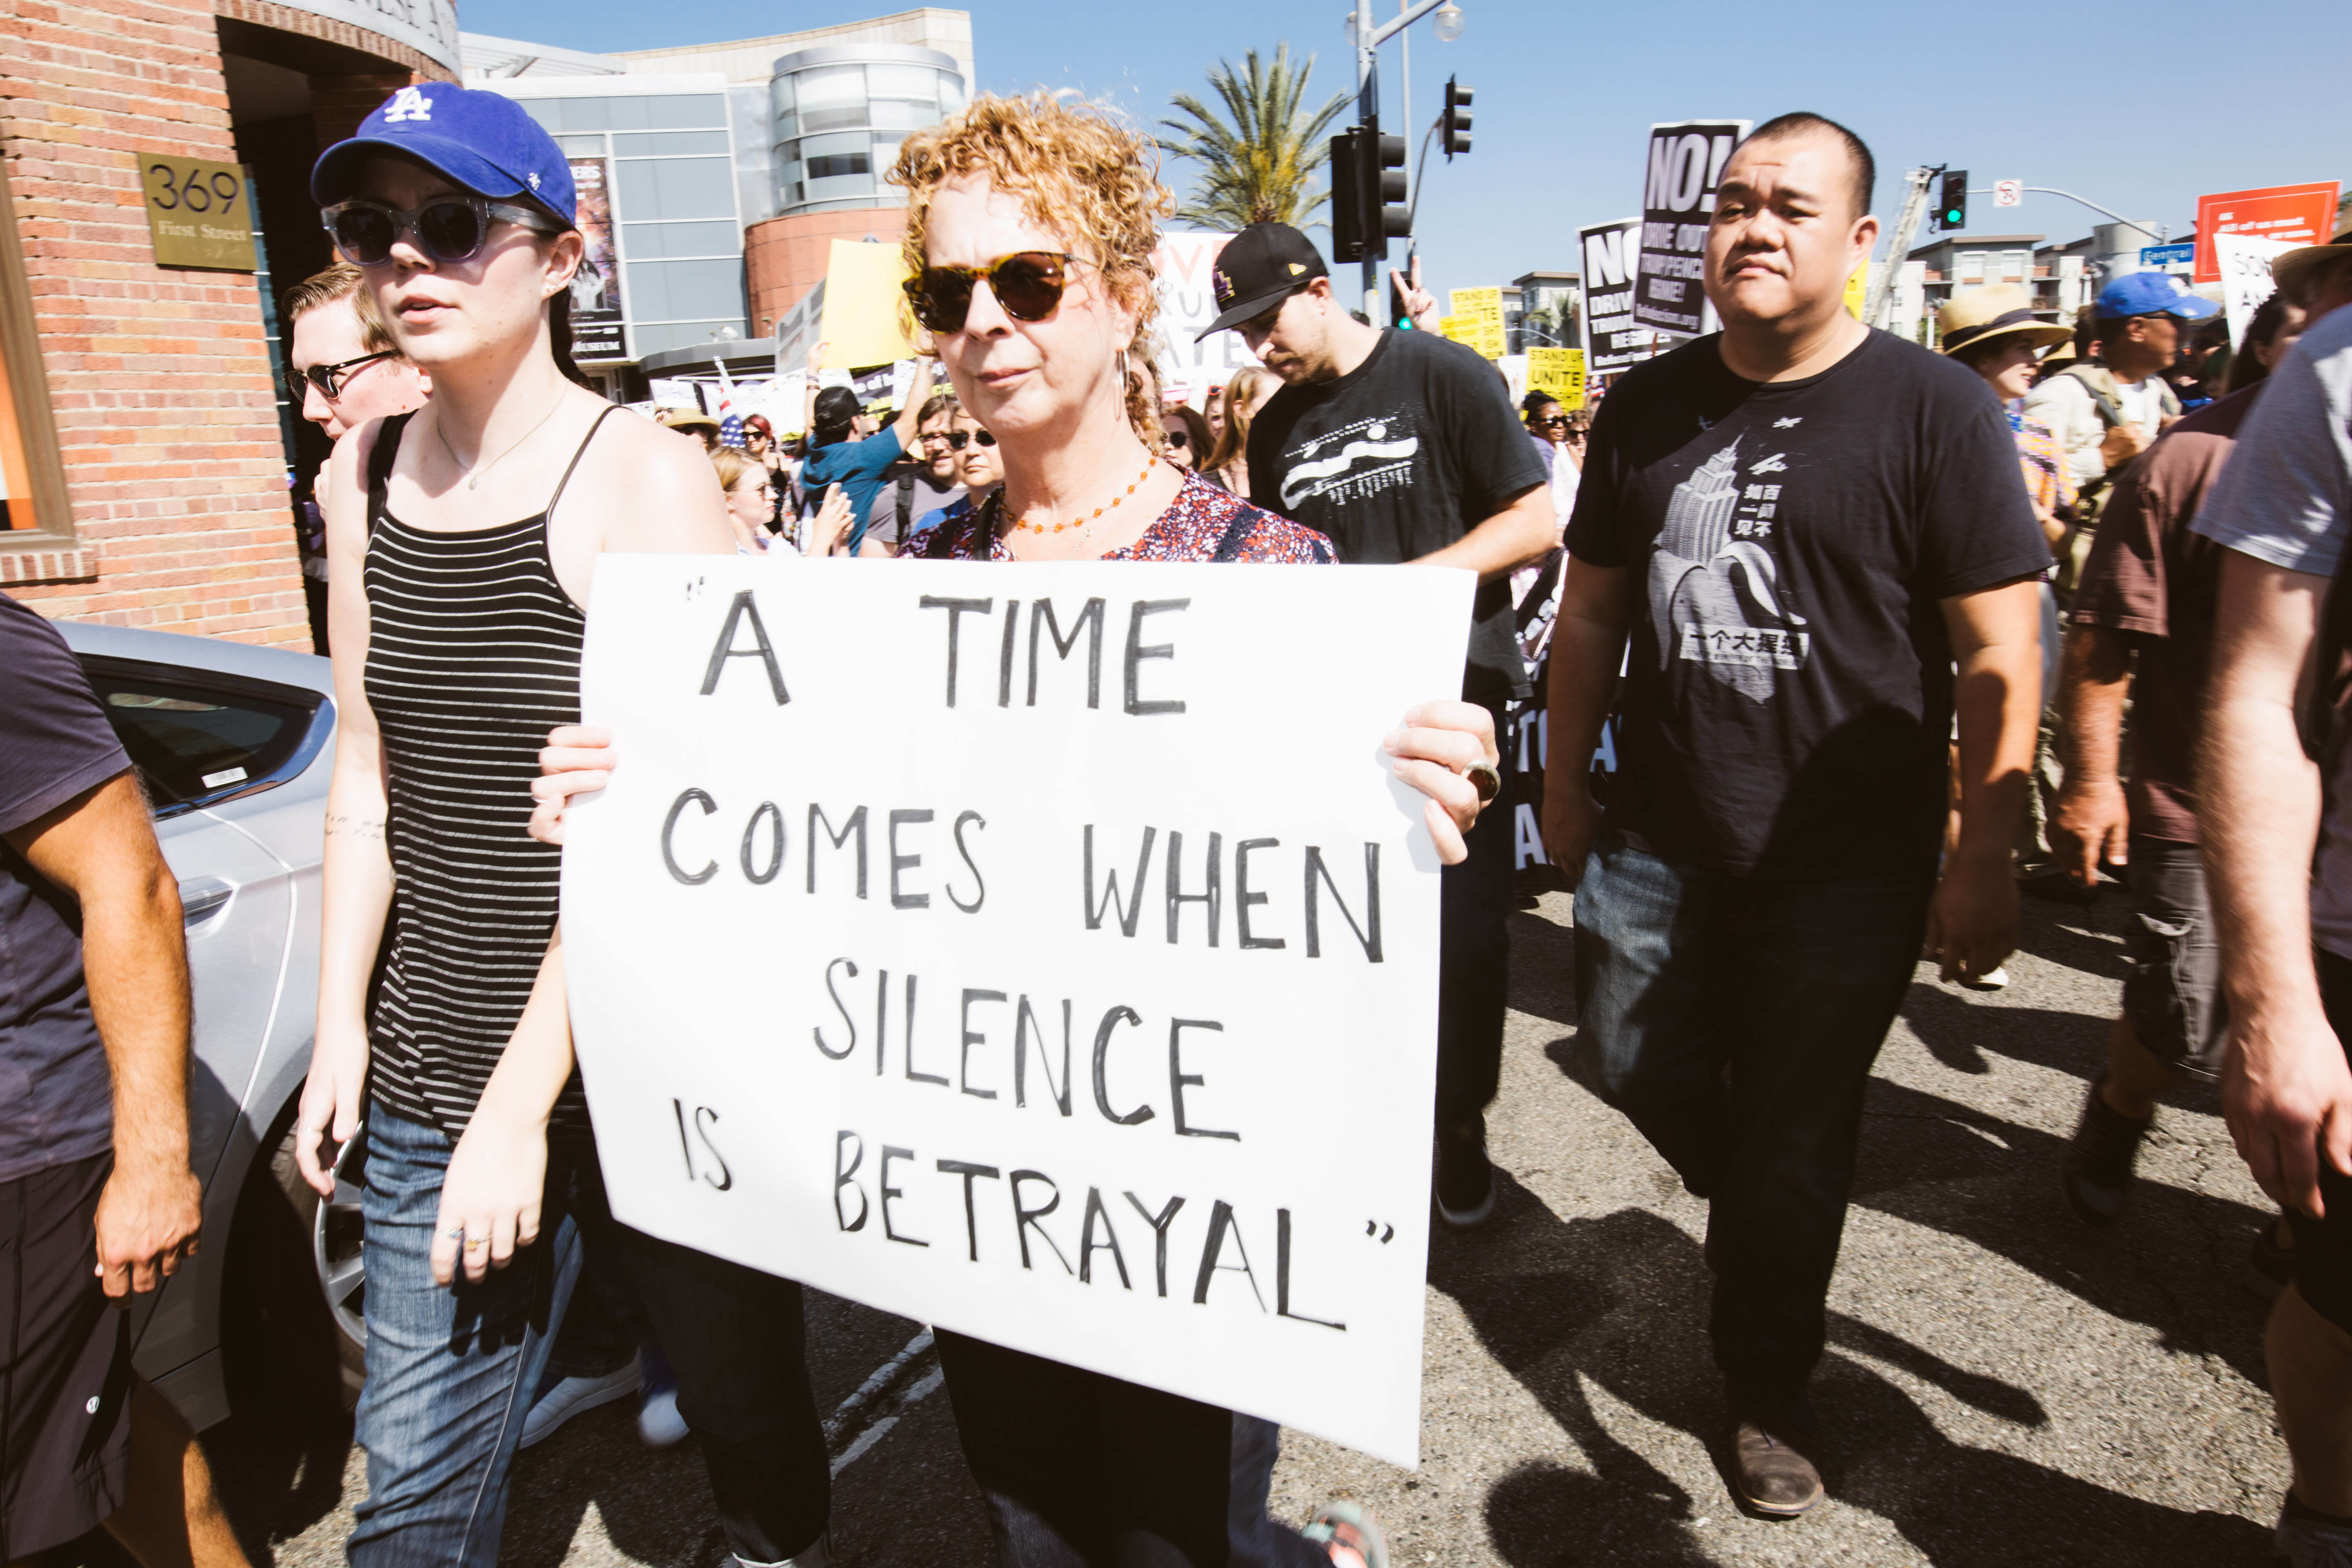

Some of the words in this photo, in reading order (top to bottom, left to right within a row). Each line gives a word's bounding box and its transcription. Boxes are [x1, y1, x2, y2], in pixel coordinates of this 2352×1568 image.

[385, 86, 433, 123] LA
[149, 164, 239, 214] 369
[1646, 134, 1735, 212] NO!
[157, 220, 196, 237] First
[200, 224, 247, 241] Street
[2143, 248, 2192, 261] Central
[1589, 290, 1634, 316] DRIV
[1530, 350, 1566, 362] STAND
[1532, 370, 1580, 387] UNITE
[920, 595, 1190, 716] TIME
[661, 787, 986, 914] COMES
[1084, 824, 1384, 963] WHEN
[813, 958, 1241, 1142] SILENCE
[673, 1098, 733, 1192] IS
